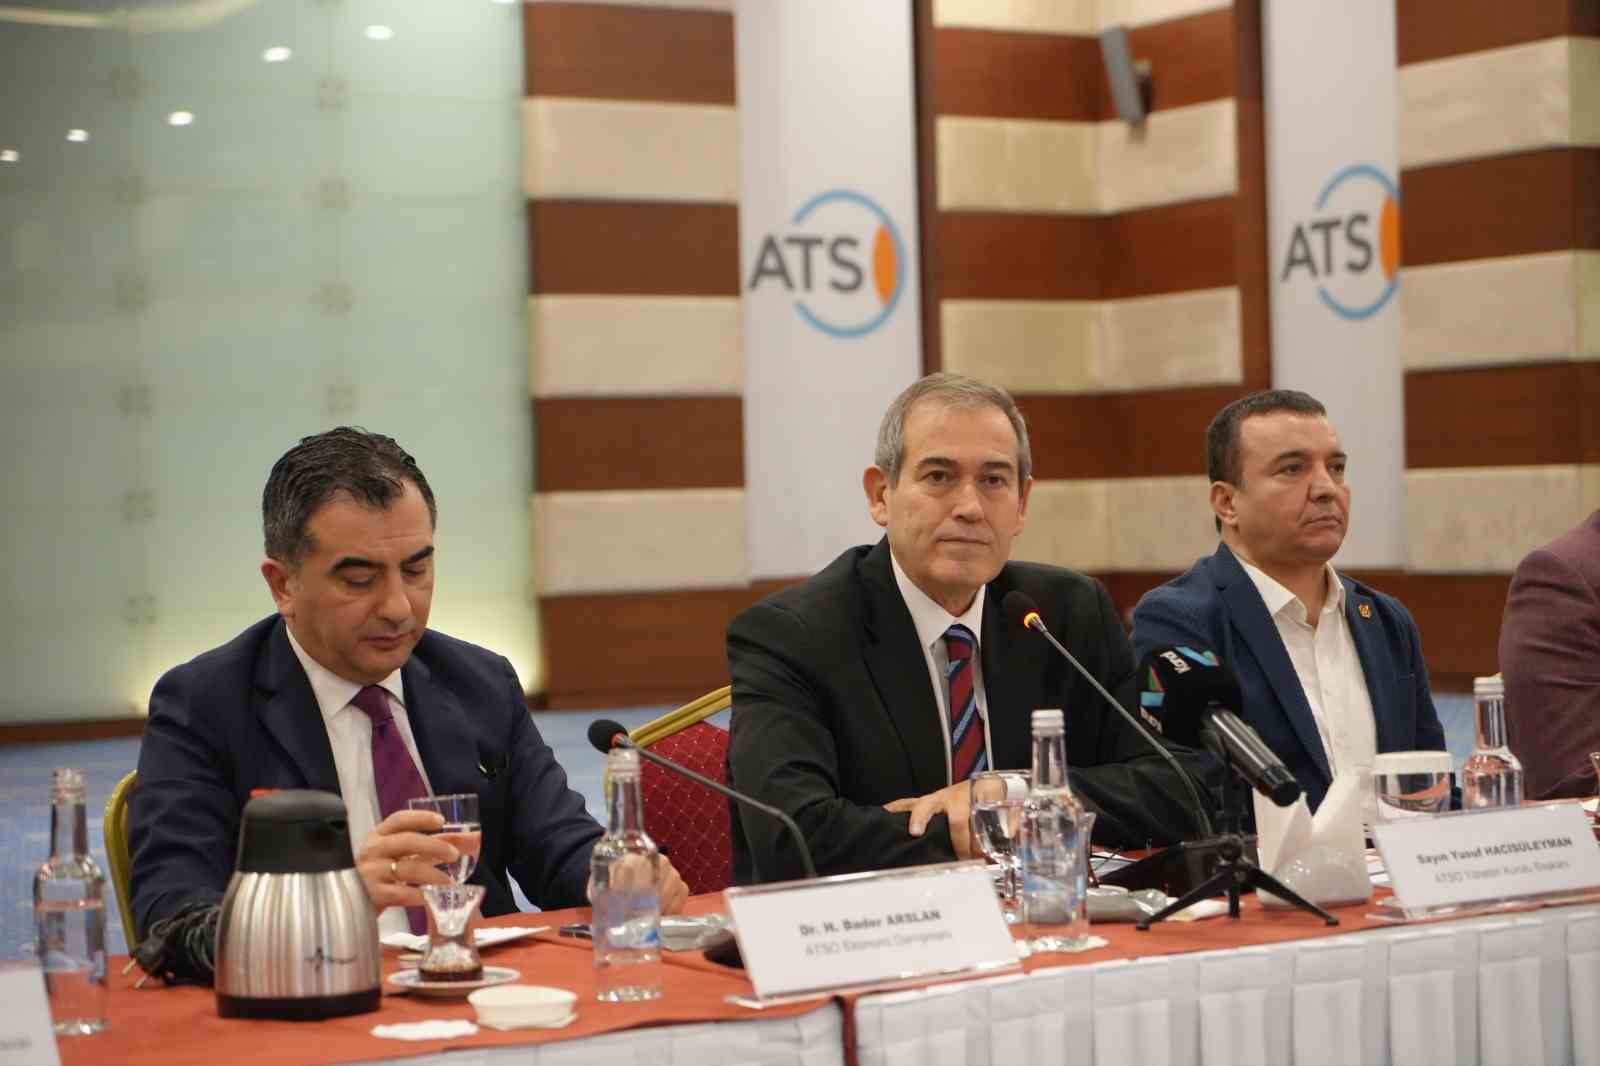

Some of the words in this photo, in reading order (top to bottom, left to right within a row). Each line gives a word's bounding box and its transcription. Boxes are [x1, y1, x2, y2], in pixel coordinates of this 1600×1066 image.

[1450, 847, 1482, 860] Yusuf
[823, 921, 839, 934] H.
[886, 909, 941, 926] ARSLAN
